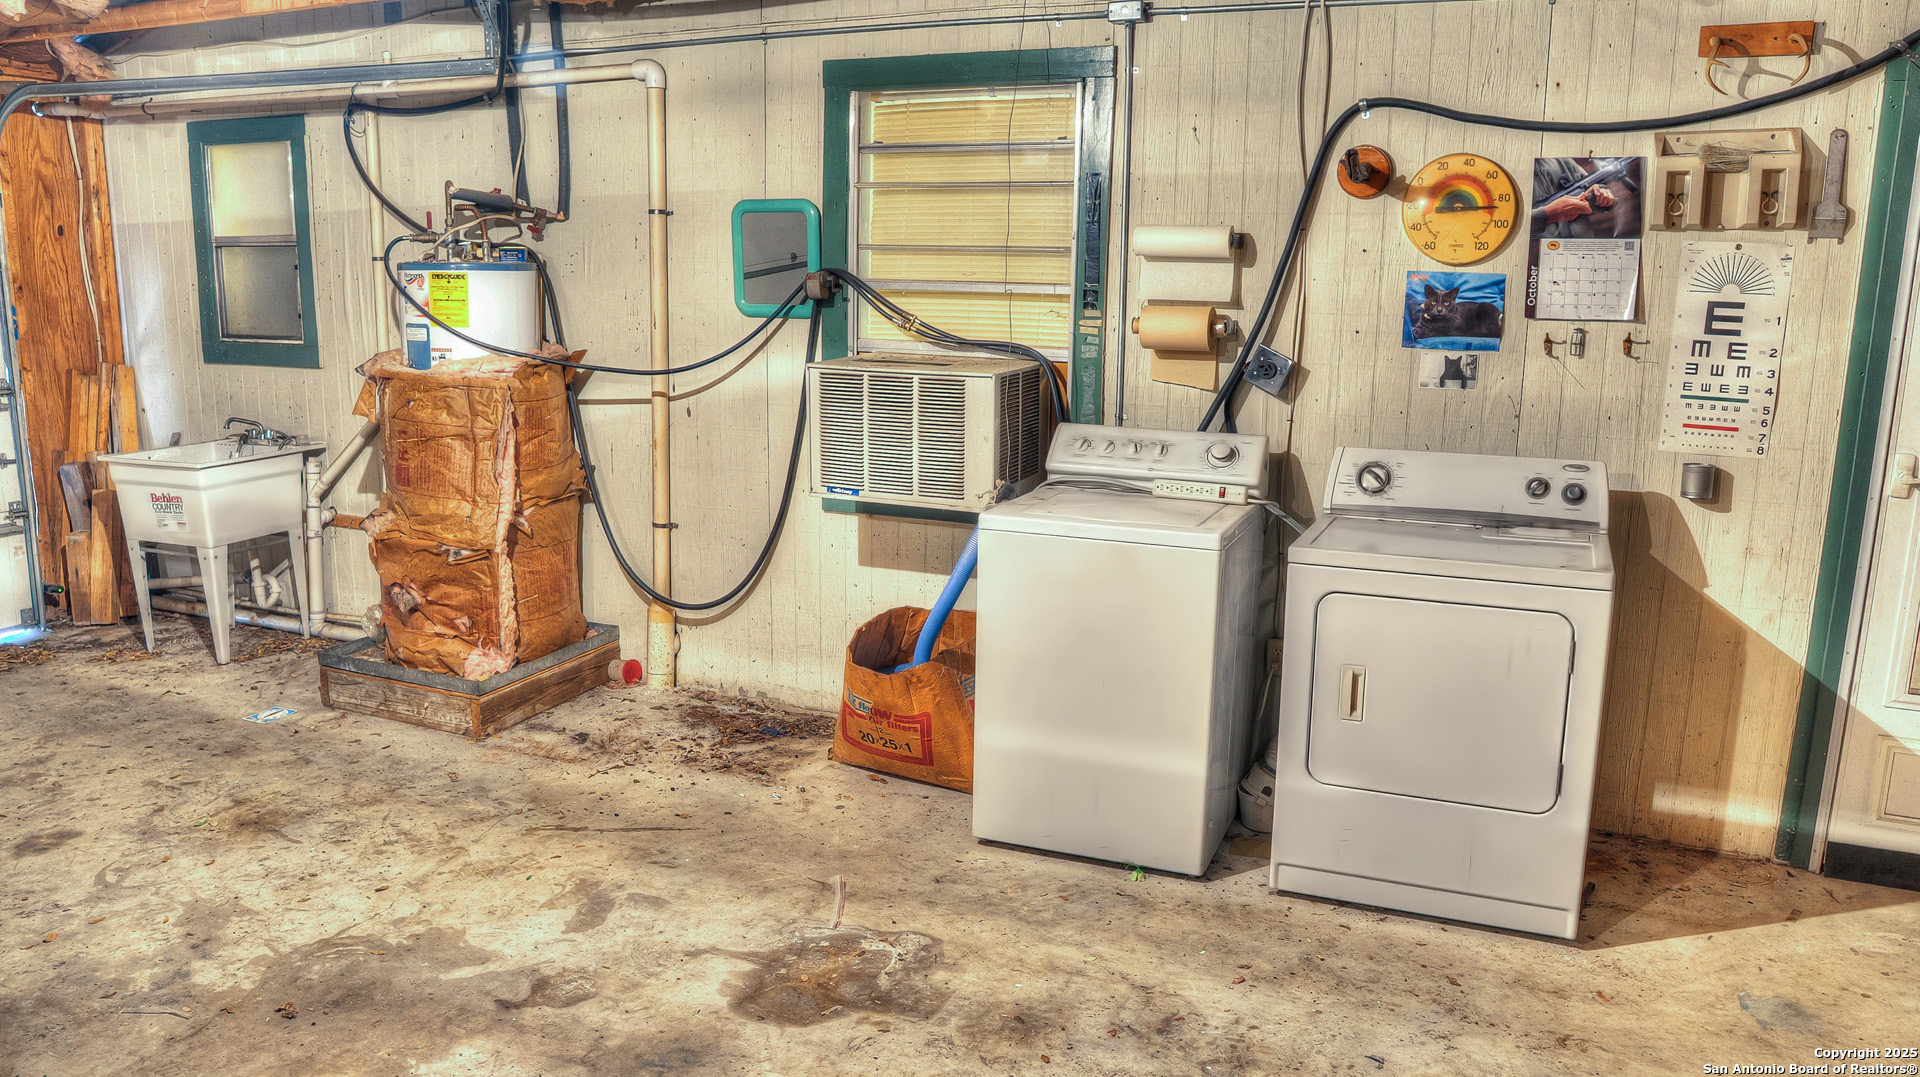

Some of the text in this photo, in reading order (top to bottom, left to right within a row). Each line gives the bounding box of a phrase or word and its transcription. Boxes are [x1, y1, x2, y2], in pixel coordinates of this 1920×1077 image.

[1437, 162, 1449, 170] 20
[1463, 158, 1476, 167] 40
[1486, 170, 1498, 179] 60
[1417, 177, 1424, 185] 0
[1498, 194, 1510, 202] 80
[1494, 220, 1509, 228] 100
[1474, 242, 1489, 250] 120
[1527, 265, 1538, 306] October
[1704, 301, 1781, 336] E 1
[1727, 342, 1748, 360] E
[1769, 348, 1778, 358] 2
[1767, 370, 1776, 378] 3
[1683, 382, 1693, 391] E
[1719, 384, 1730, 393] E
[1764, 388, 1774, 396] 4
[1762, 406, 1770, 415] 5
[1761, 419, 1768, 427] 6
[1758, 434, 1766, 442] 7
[1757, 446, 1764, 455] 8
[150, 493, 183, 503] Behlen
[887, 721, 919, 732] filters
